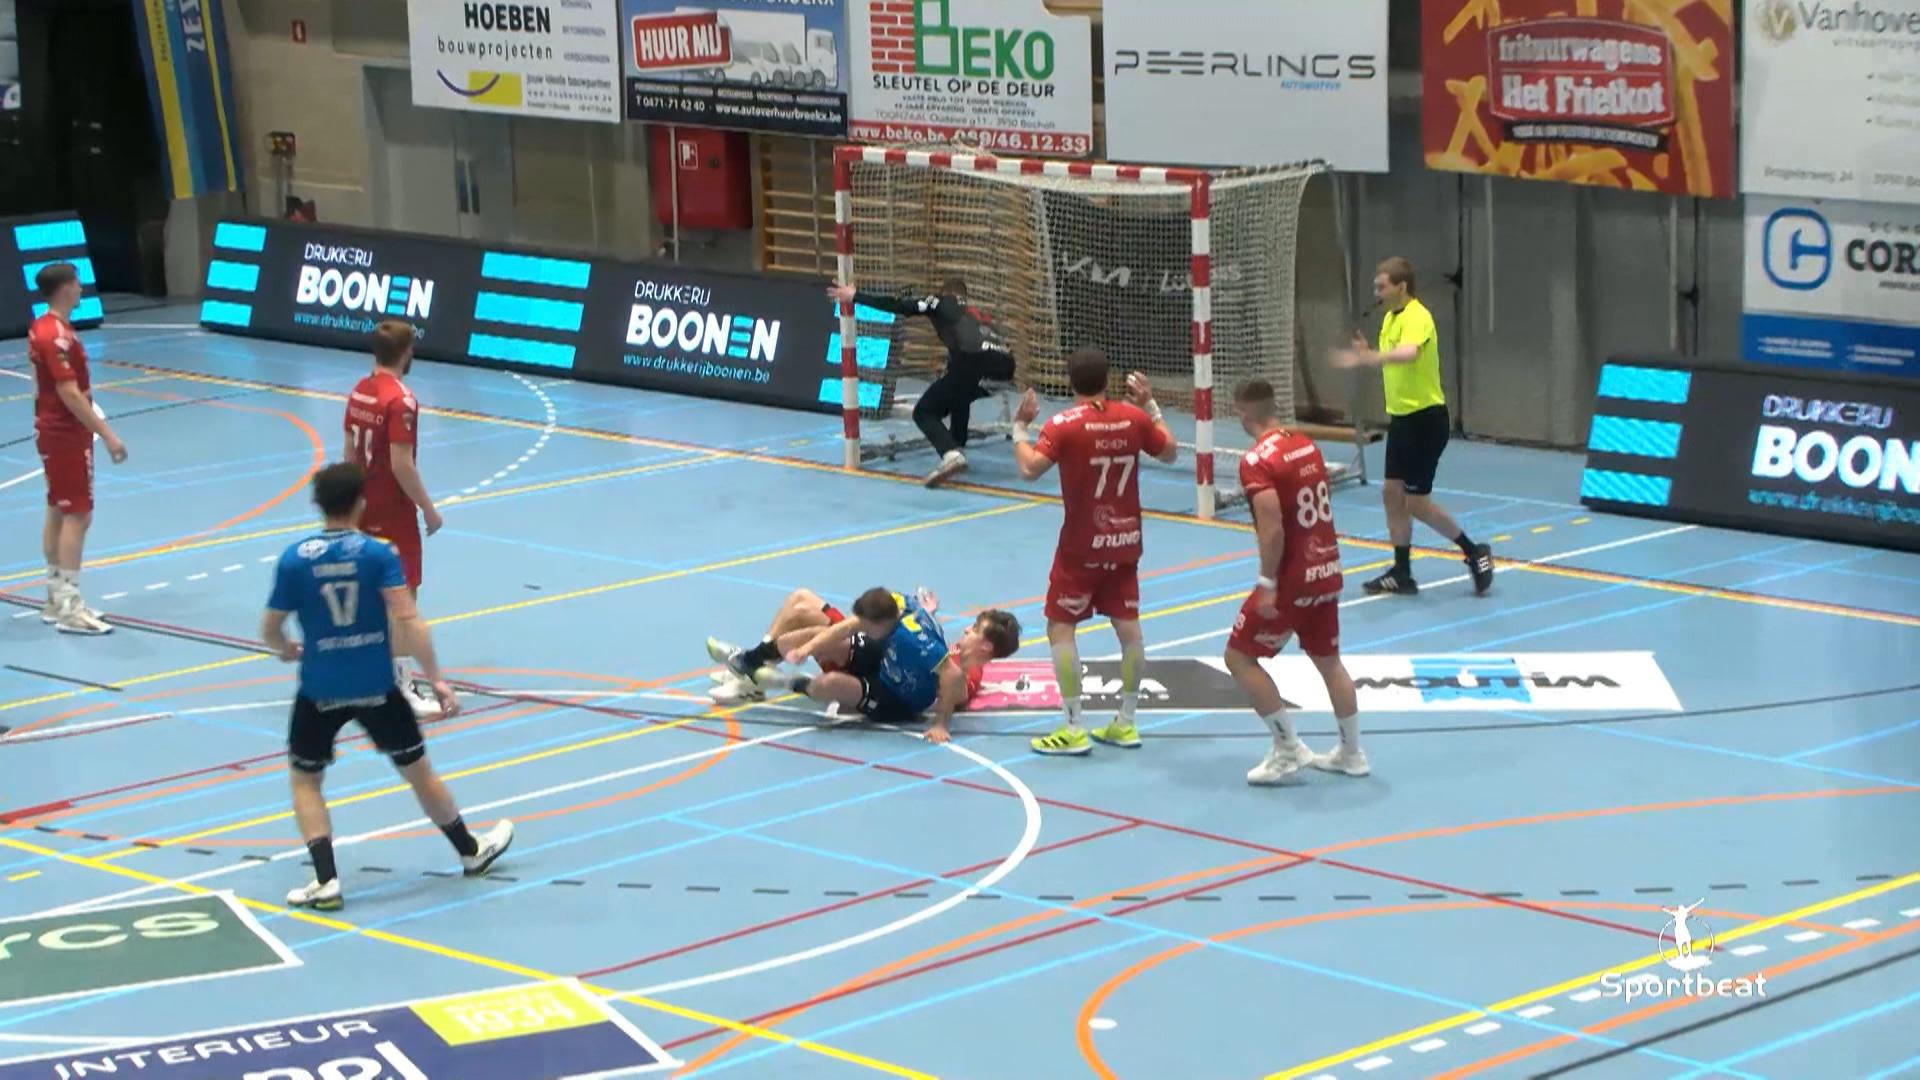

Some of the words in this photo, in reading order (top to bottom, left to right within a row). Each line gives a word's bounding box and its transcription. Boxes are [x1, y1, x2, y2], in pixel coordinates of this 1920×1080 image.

[465, 4, 551, 34] HOEBEN
[438, 36, 553, 61] bouwprojecten
[640, 26, 689, 61] HUUR
[692, 24, 722, 57] MIJ
[914, 0, 1055, 81] BEKO
[1499, 33, 1662, 71] frituurwagens
[1115, 50, 1375, 78] PEERLINGS
[874, 75, 941, 92] SLEUTEL
[947, 78, 972, 93] OP
[977, 80, 1000, 95] DE
[1006, 82, 1055, 97] DEUR
[1502, 75, 1549, 112] Het
[1555, 77, 1665, 115] Frietkot
[296, 265, 434, 318] BOONEN
[626, 303, 780, 361] BOONEN
[623, 353, 770, 383] www.drukkerijboonen.be
[1089, 455, 1136, 499] 77
[1296, 480, 1333, 528] 88
[320, 581, 358, 627] 17
[454, 1000, 576, 1035] 1934
[54, 1018, 378, 1080] INTERIEUR
